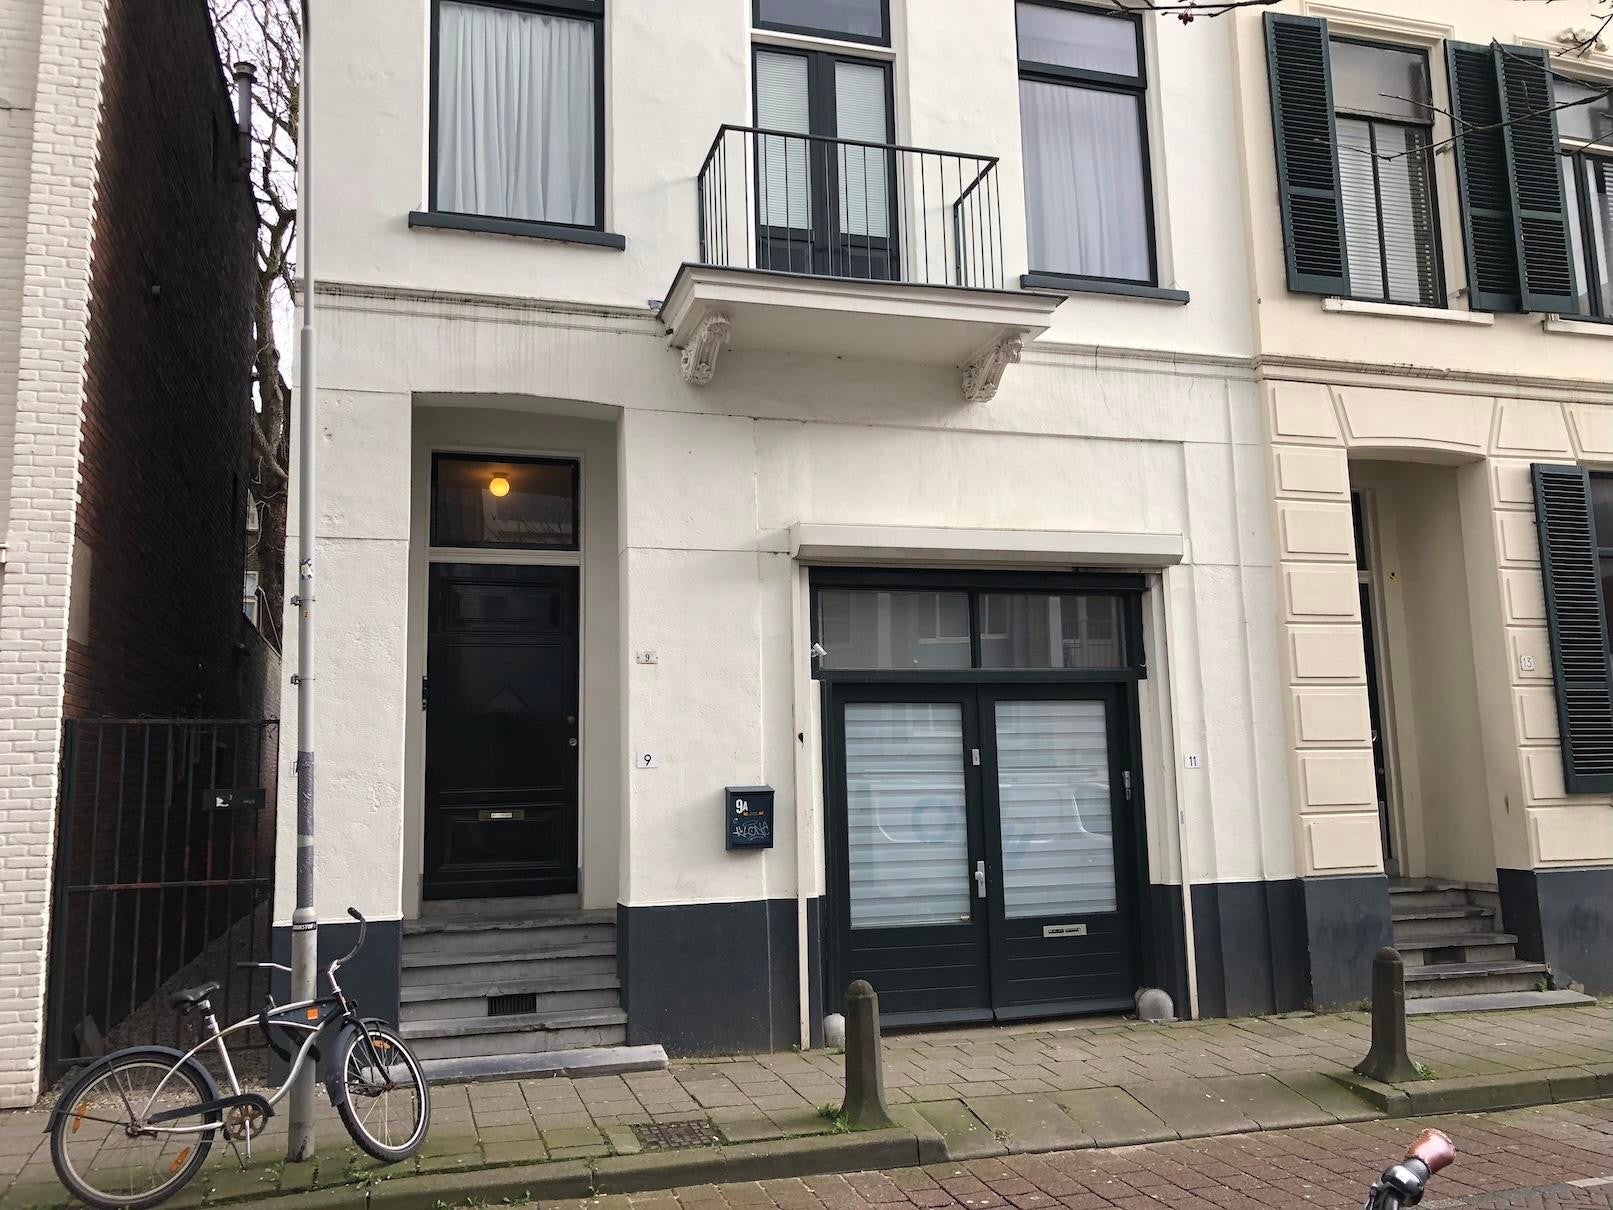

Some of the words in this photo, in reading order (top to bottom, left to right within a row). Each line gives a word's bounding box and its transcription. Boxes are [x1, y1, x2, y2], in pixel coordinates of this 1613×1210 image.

[644, 754, 652, 766] 9
[1189, 756, 1197, 767] 11
[735, 799, 749, 814] 9A
